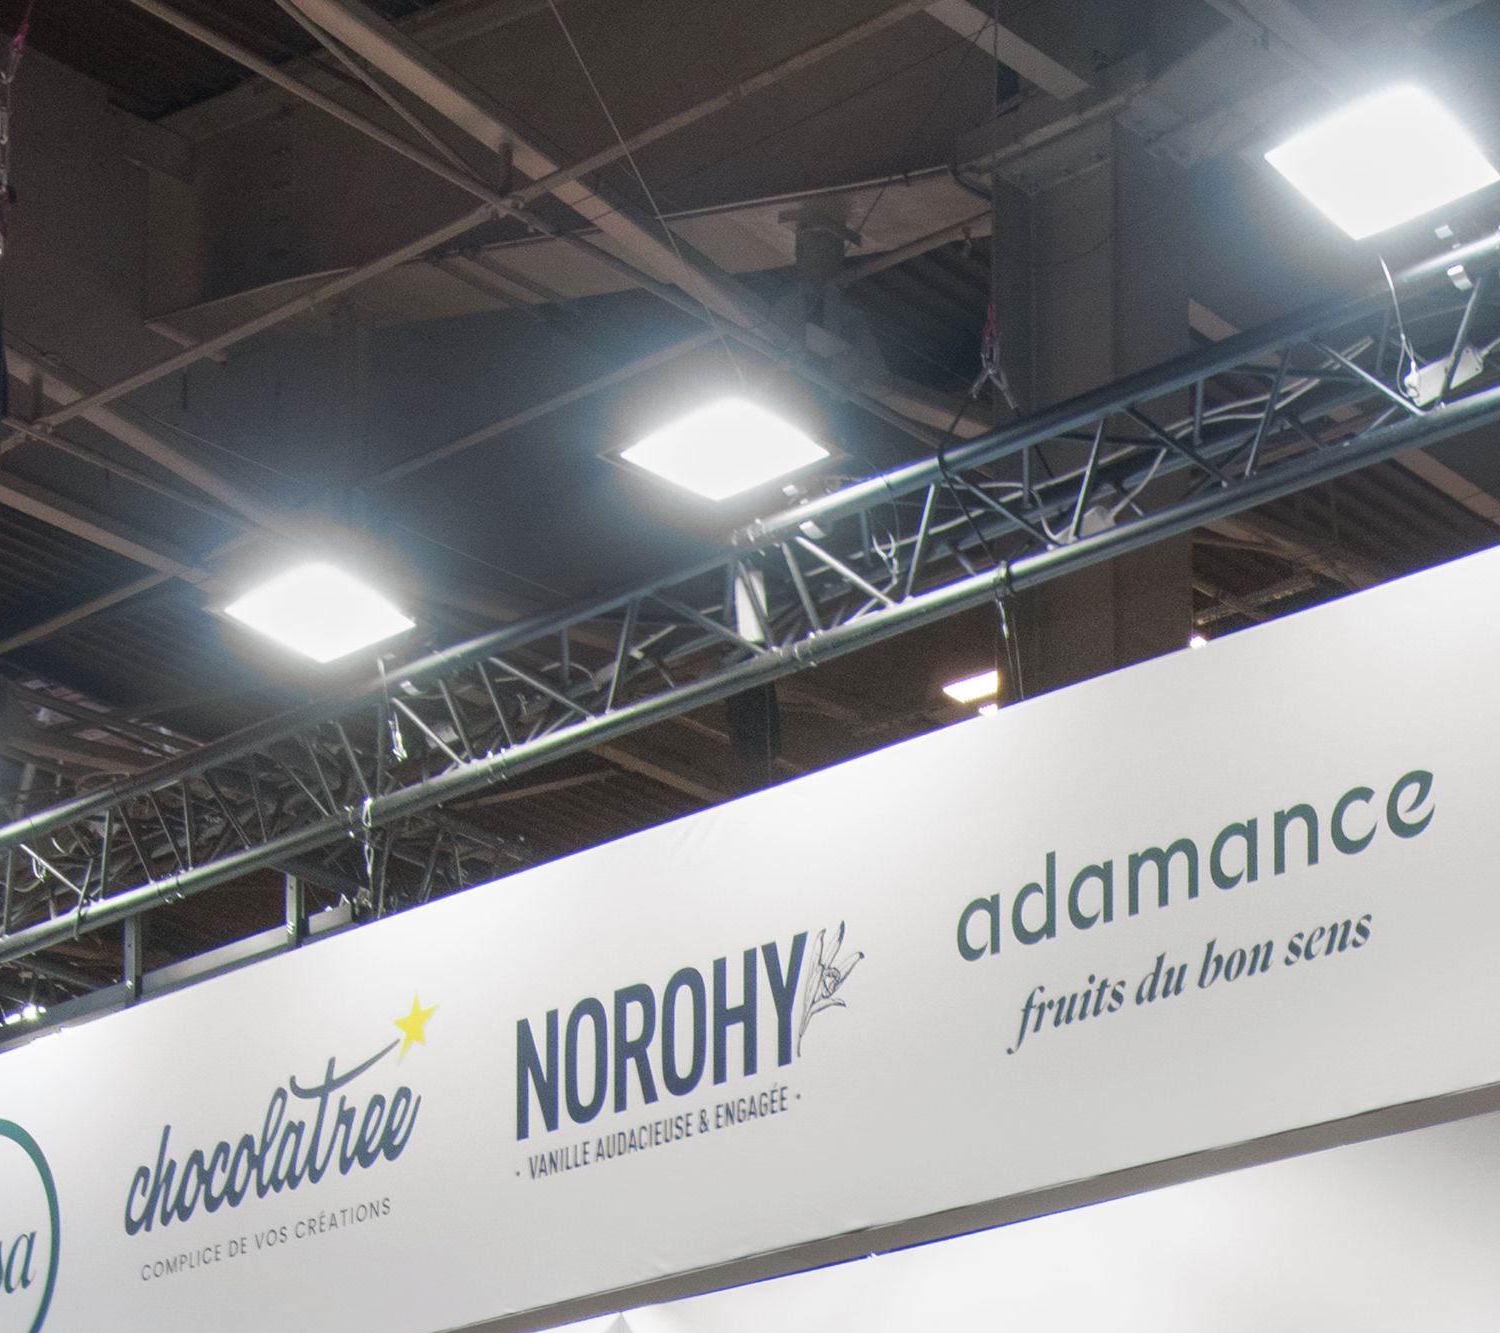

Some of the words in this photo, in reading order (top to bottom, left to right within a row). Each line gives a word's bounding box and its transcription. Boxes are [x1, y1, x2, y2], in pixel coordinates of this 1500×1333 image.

[957, 769, 1436, 962] adamance
[516, 931, 808, 1141] NOROHY
[1006, 974, 1126, 1055] fruits
[1136, 952, 1188, 1006] du
[1197, 937, 1274, 989] bon
[1284, 913, 1373, 966] sens
[529, 1141, 590, 1180] VANILLE
[595, 1112, 693, 1162] AUDACIEUSE
[700, 1108, 709, 1134] &
[715, 1082, 788, 1130] ENGAGÉE
[141, 1245, 222, 1281] COMPLICE
[229, 1237, 247, 1258] DE
[254, 1226, 288, 1250] VOS
[295, 1197, 391, 1239] CRÉATIONS
